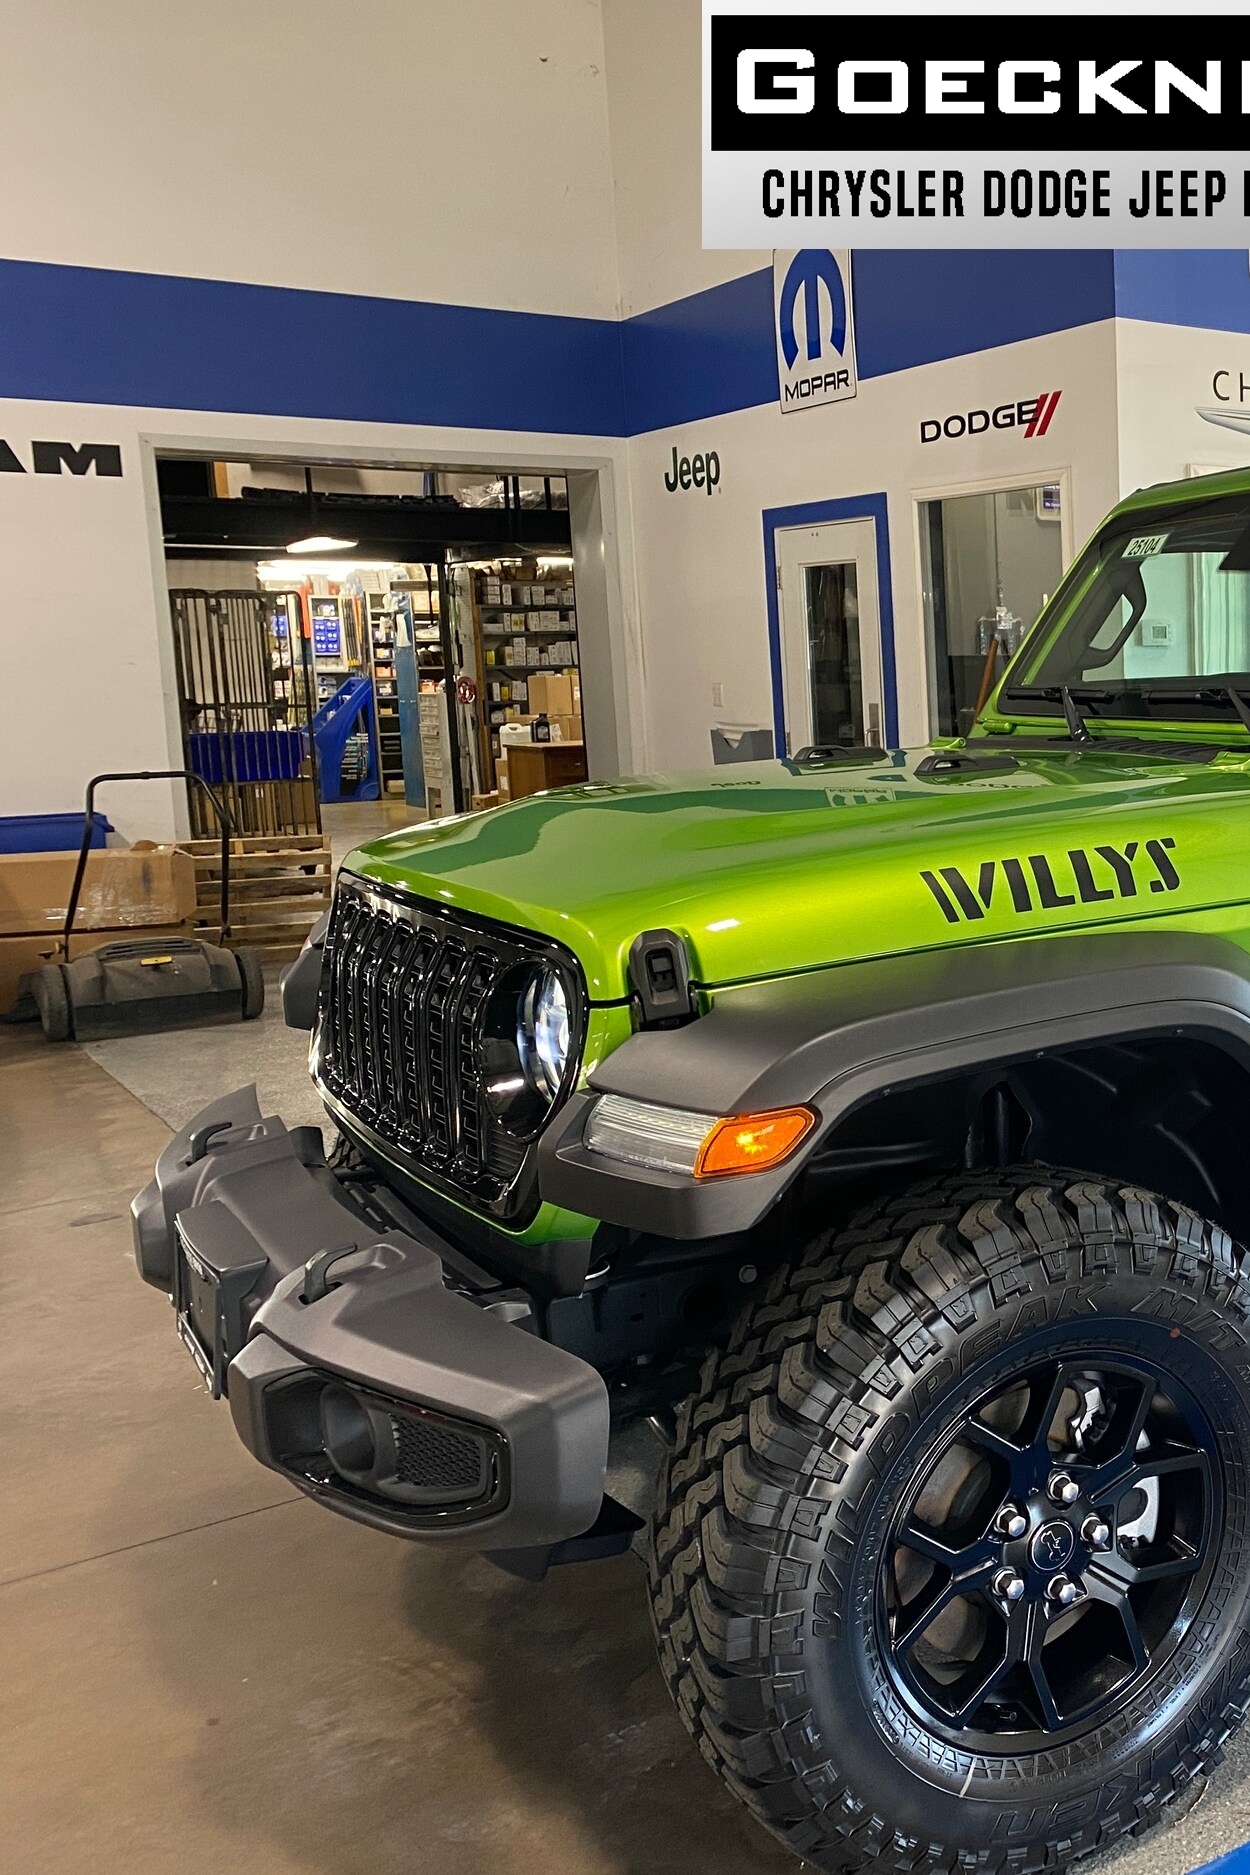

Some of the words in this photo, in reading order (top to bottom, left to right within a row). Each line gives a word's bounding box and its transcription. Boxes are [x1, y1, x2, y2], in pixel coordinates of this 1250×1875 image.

[785, 369, 850, 402] MOPAR
[920, 398, 1041, 443] DODGE
[664, 446, 721, 496] Jeep
[1127, 537, 1162, 556] 25104
[919, 837, 1180, 923] WILLYS
